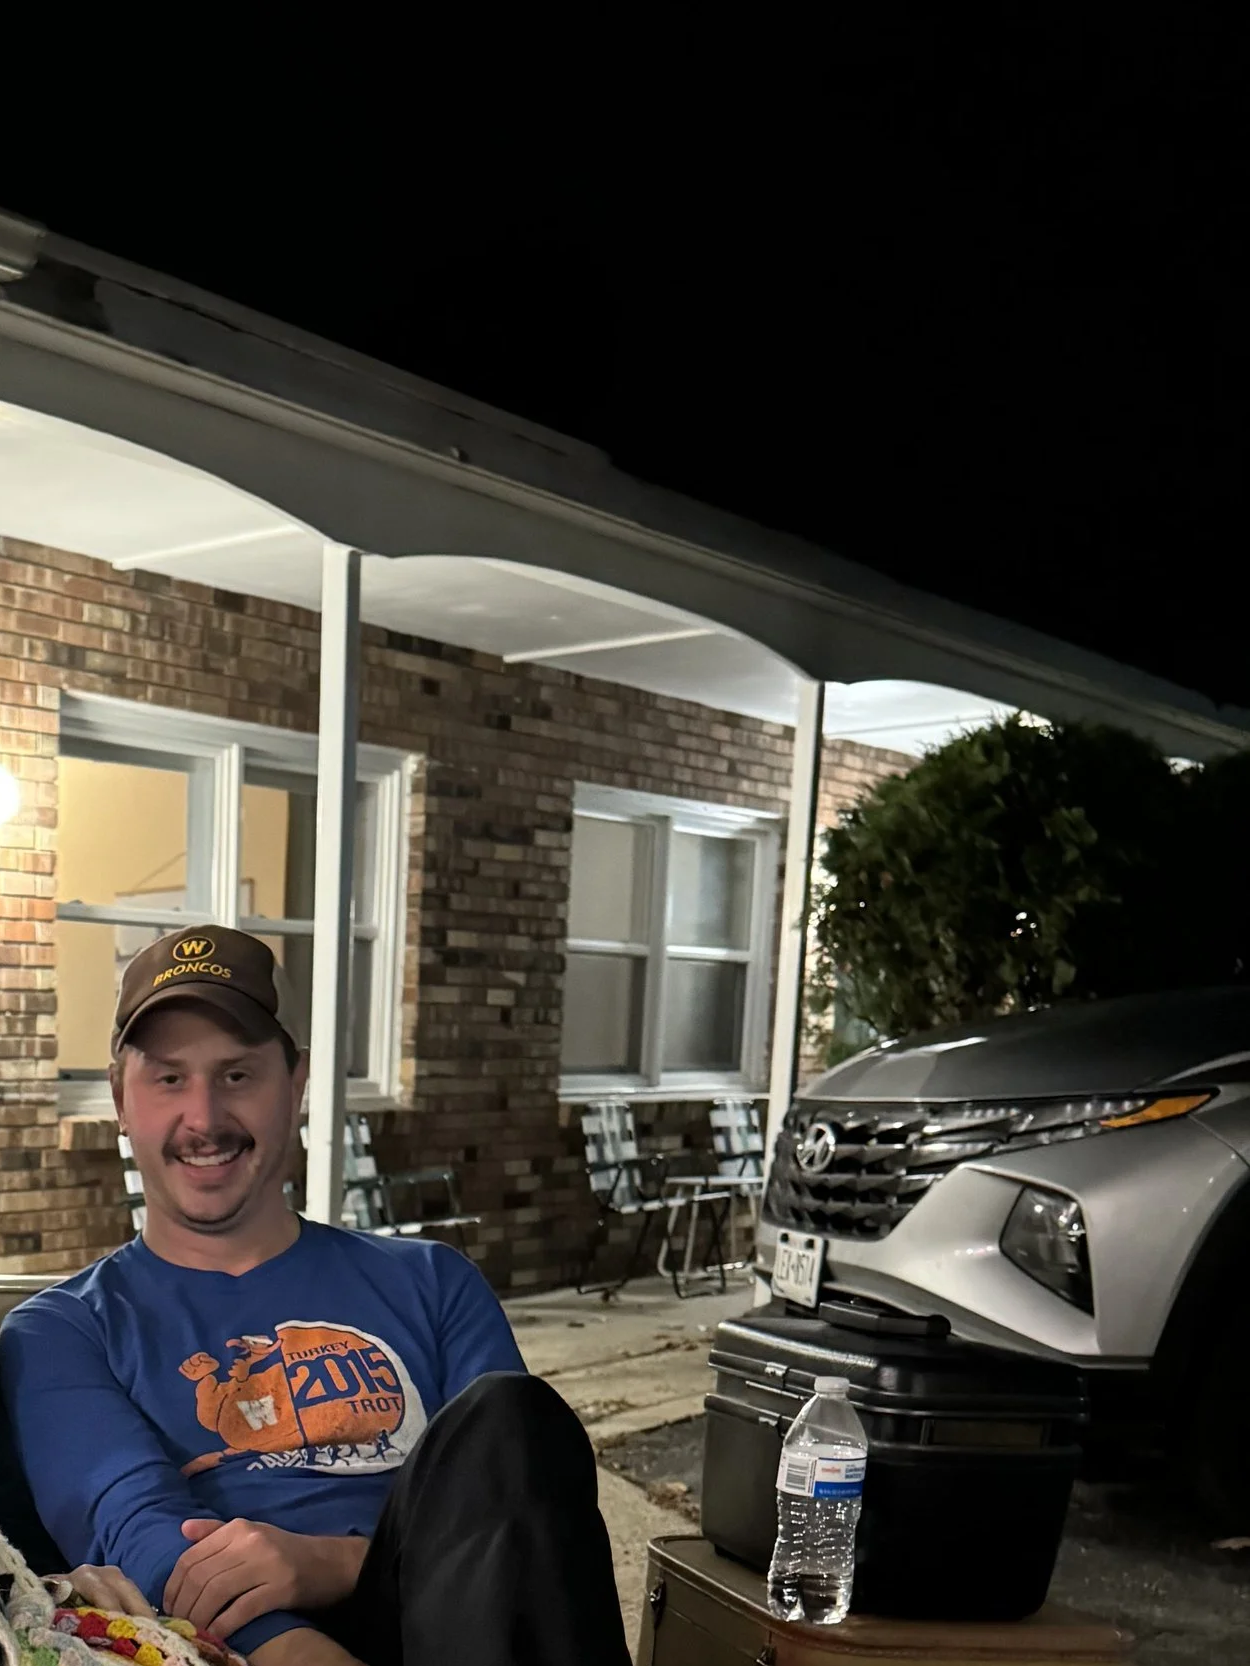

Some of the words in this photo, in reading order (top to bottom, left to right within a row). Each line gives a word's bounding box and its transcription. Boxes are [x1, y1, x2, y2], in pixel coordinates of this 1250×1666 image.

[182, 940, 207, 956] W
[153, 961, 232, 987] BRONCOS
[286, 1341, 350, 1361] TURKEY
[287, 1347, 402, 1411] 2015
[346, 1398, 401, 1414] TROT
